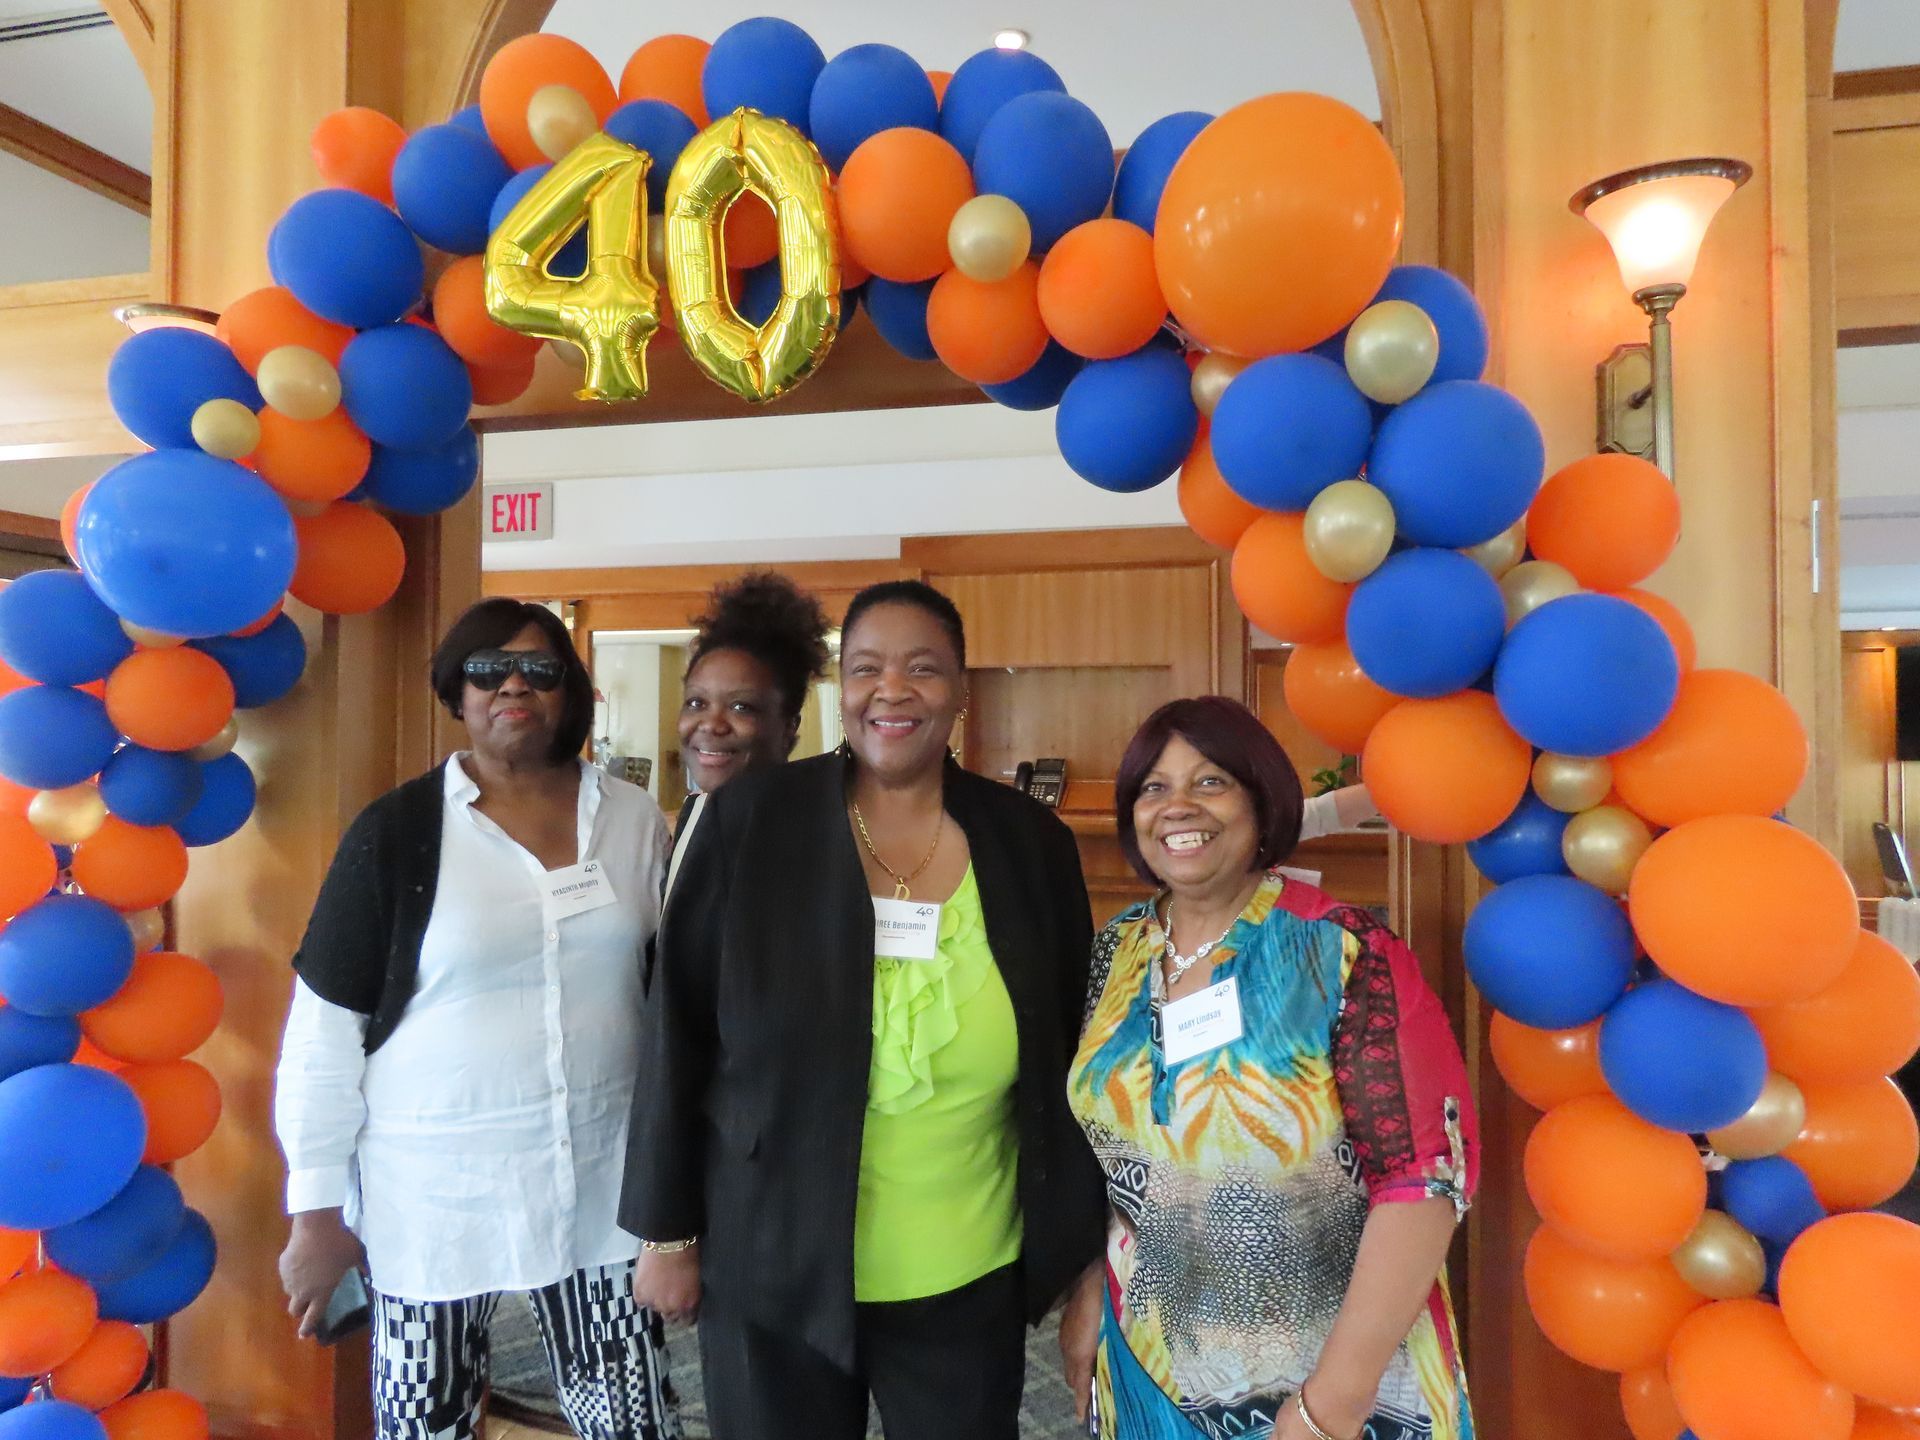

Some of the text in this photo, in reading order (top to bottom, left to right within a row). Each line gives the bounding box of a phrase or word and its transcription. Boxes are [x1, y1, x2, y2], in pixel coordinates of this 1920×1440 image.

[483, 106, 841, 404] 40
[492, 492, 542, 533] EXIT
[584, 863, 598, 873] 40
[916, 906, 934, 917] 40
[892, 920, 927, 931] Benjamin
[1214, 984, 1231, 998] 40
[1177, 1019, 1196, 1032] MARY
